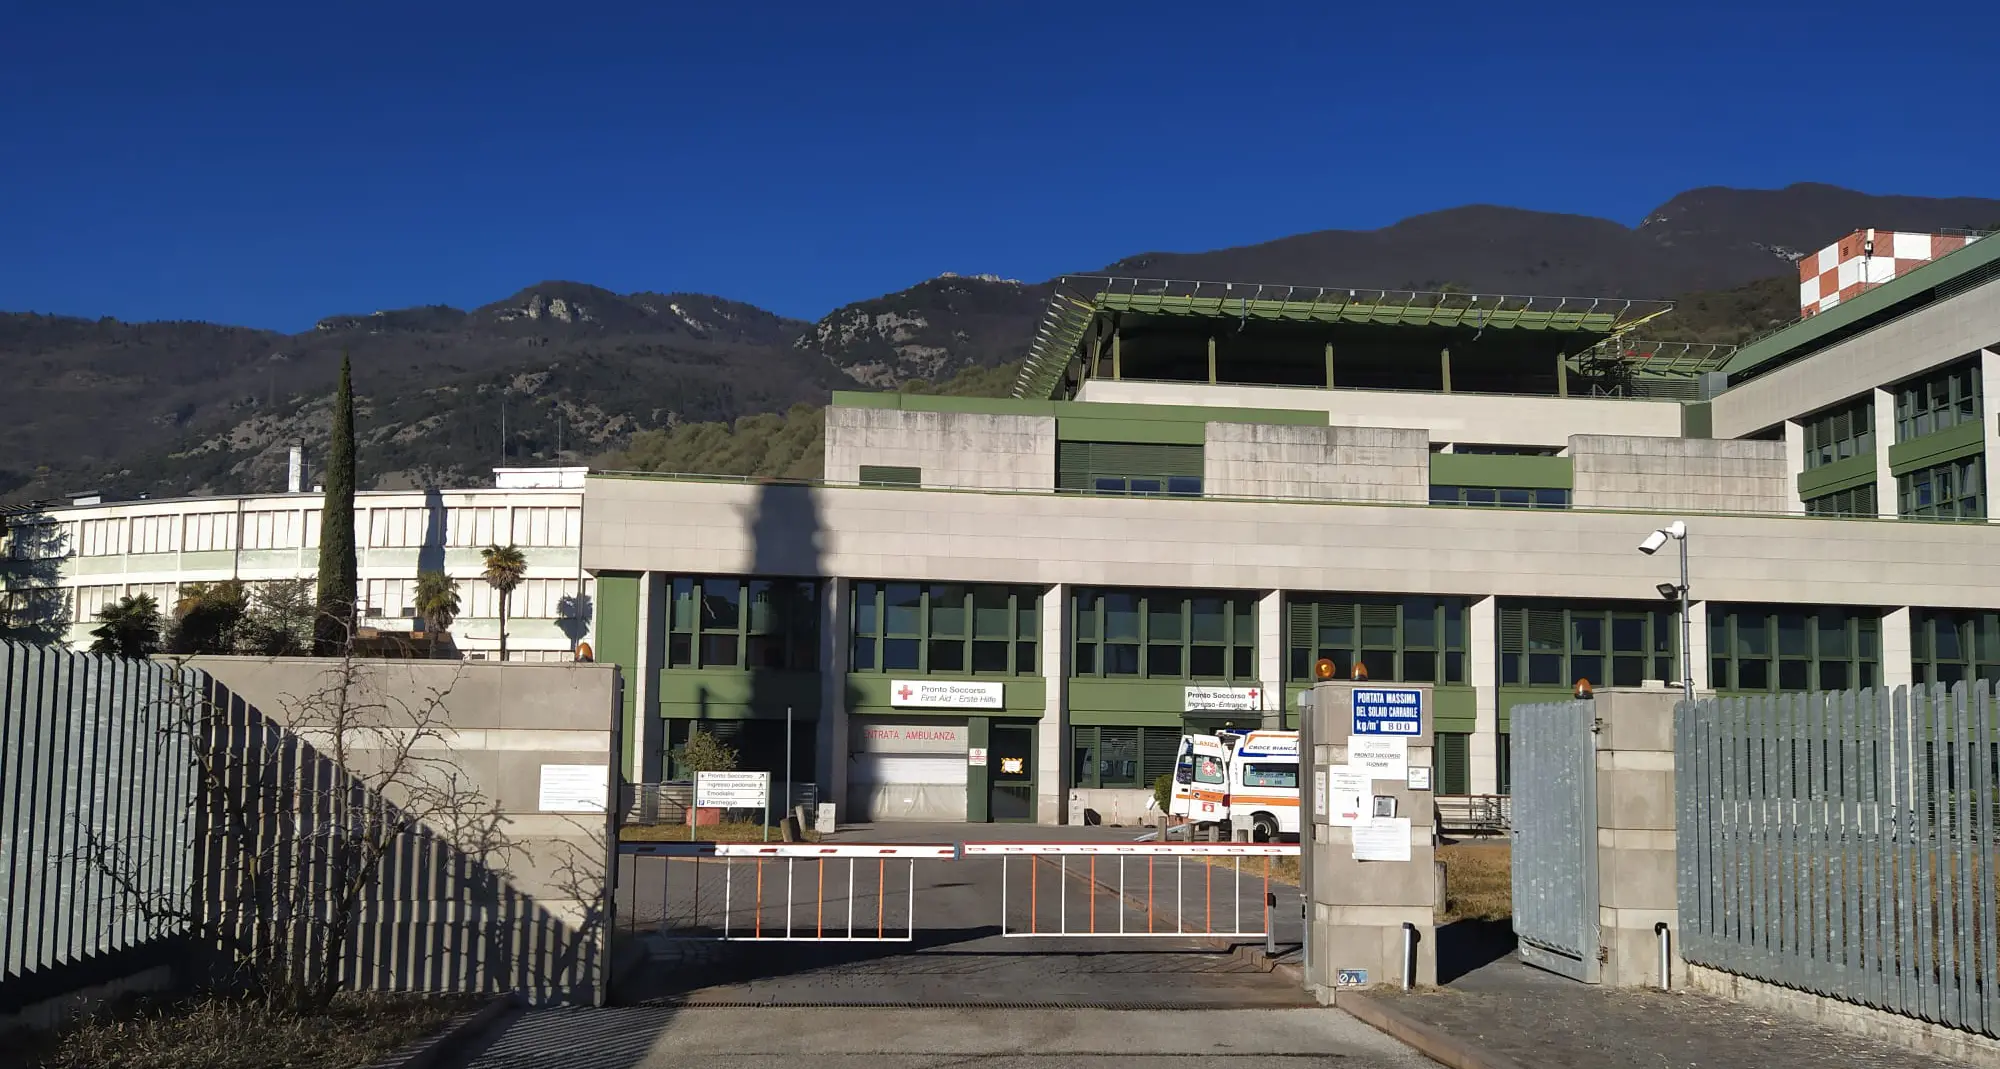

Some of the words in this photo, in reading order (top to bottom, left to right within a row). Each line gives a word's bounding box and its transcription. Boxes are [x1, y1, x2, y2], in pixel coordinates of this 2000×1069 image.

[921, 685, 947, 693] Pronto
[949, 686, 986, 694] Soccorso
[920, 694, 937, 702] First
[939, 694, 952, 702] Aid
[959, 695, 978, 703] Erste
[1187, 691, 1211, 699] Pronto
[1358, 692, 1384, 704] PORTATA
[1386, 693, 1417, 705] MASSIMA
[1356, 706, 1367, 717] DEL
[1368, 706, 1387, 717] SOLAIO
[1388, 707, 1418, 718] CARRABILE
[905, 730, 955, 741] AMBULANZA
